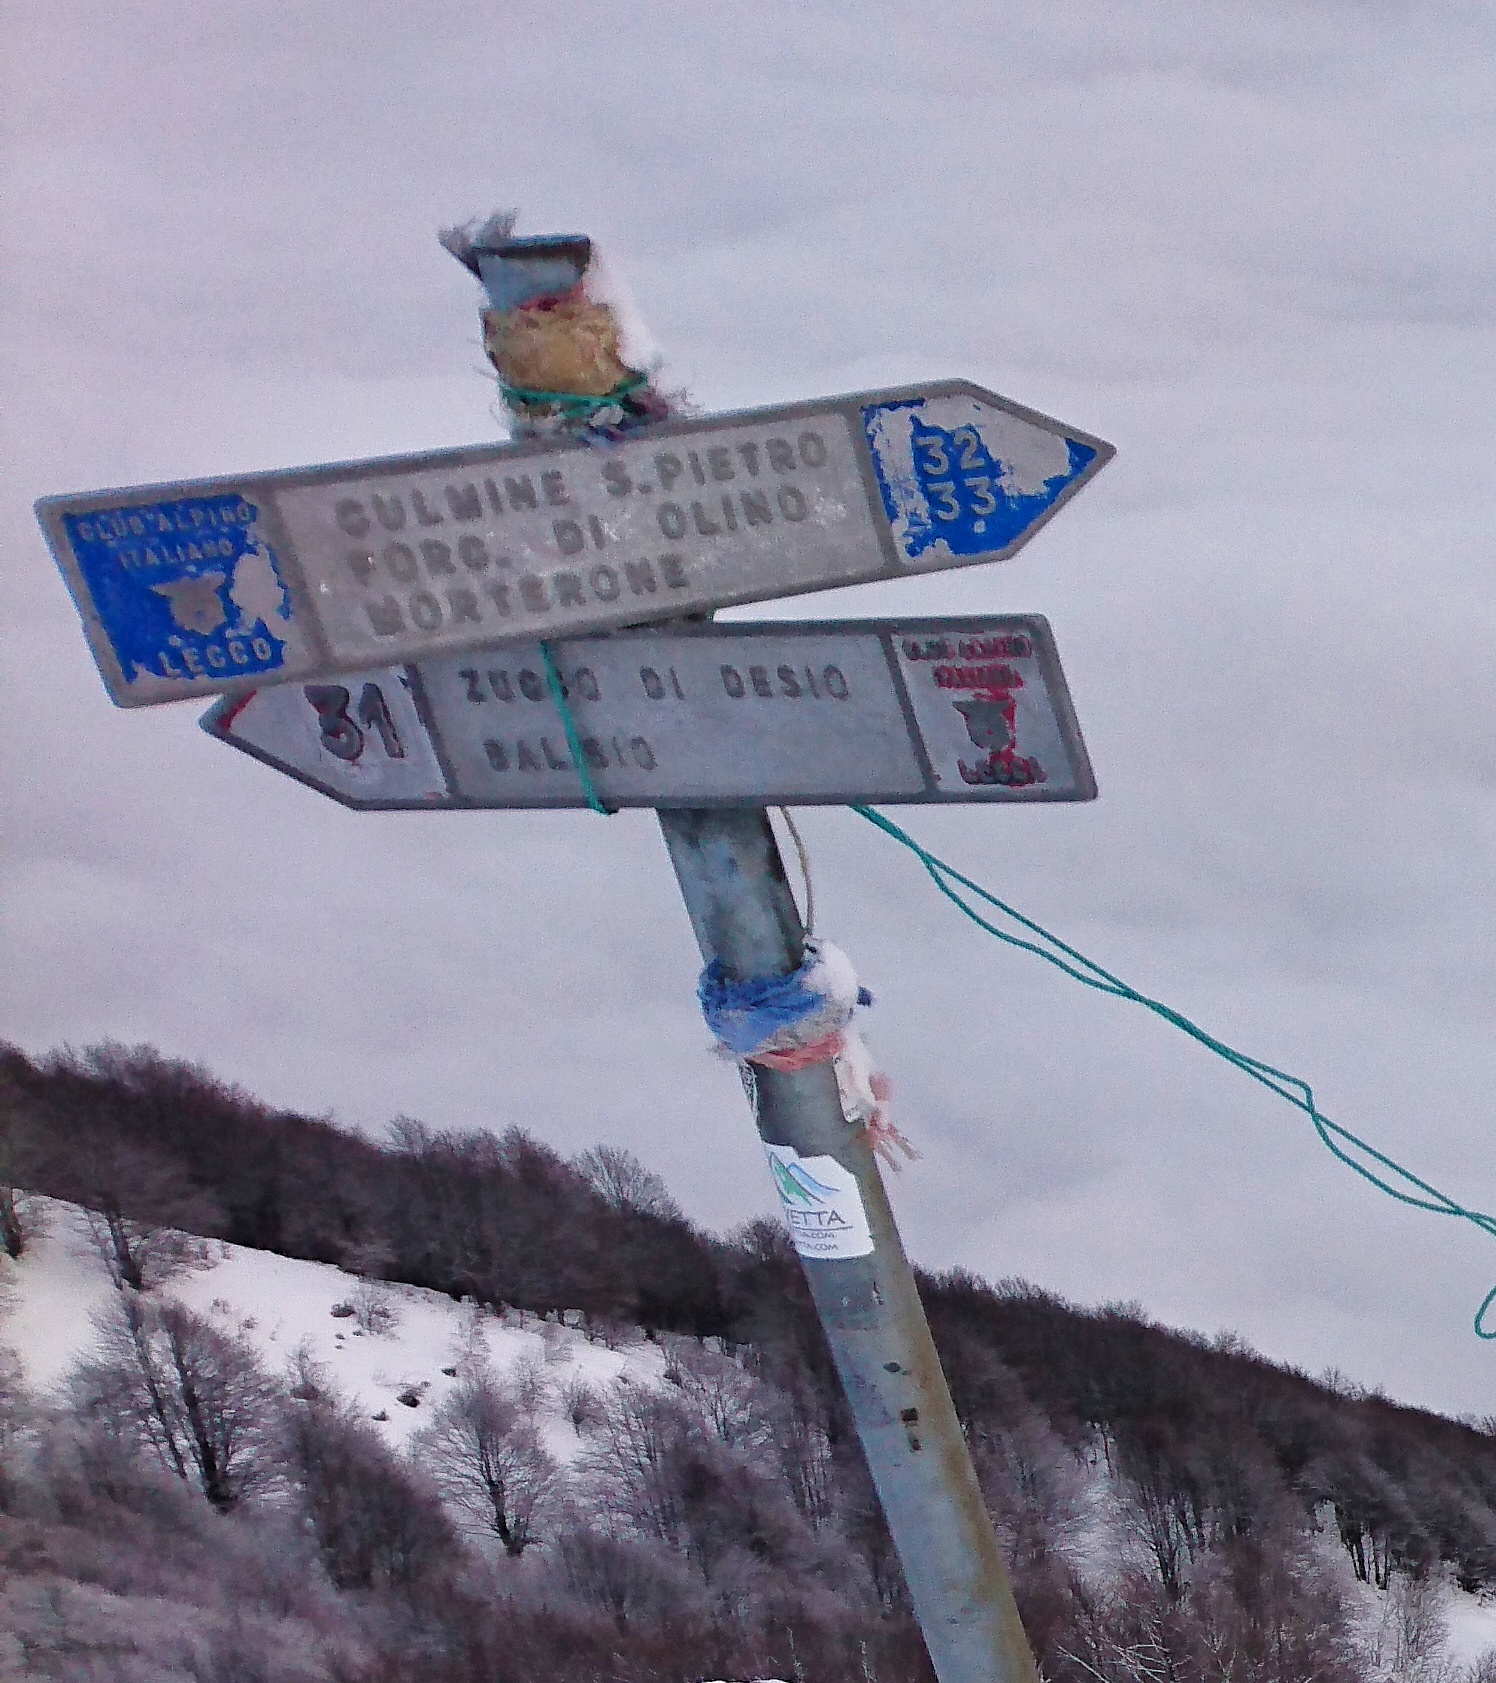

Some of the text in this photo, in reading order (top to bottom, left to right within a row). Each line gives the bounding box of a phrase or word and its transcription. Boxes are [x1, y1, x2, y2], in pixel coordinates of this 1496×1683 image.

[917, 429, 986, 475] 32
[335, 469, 571, 538] CULMINE
[552, 513, 605, 556] DI
[656, 484, 808, 540] OLINO
[926, 475, 997, 521] 33
[363, 552, 691, 636] MORTERONE
[158, 637, 273, 678] LECCO
[638, 664, 686, 700] DI
[719, 663, 851, 700] DESIO
[302, 682, 405, 765] 31
[482, 735, 659, 772] BALSIO
